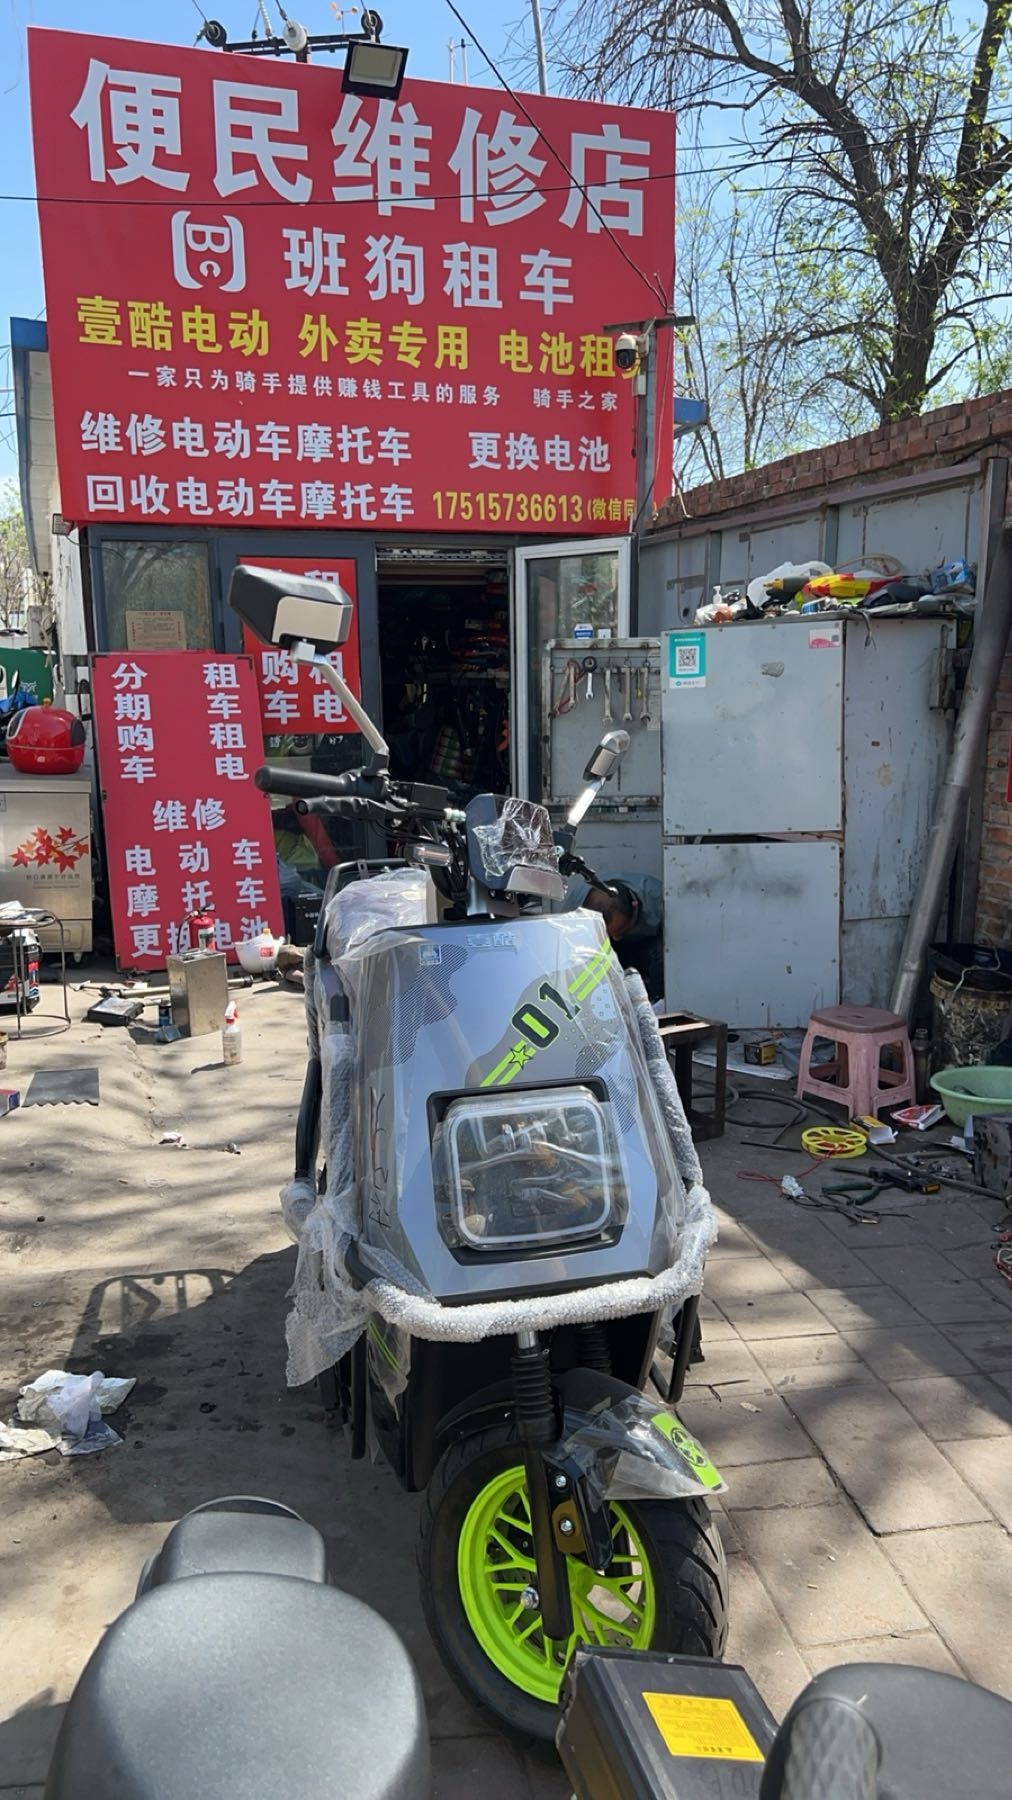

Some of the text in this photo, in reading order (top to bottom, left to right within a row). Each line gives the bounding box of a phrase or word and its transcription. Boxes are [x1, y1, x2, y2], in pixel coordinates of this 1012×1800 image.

[70, 58, 651, 236] 便民维修店
[282, 227, 574, 315] 班狗租车
[76, 295, 641, 379] 壹酷电动 外卖专用 电池租
[128, 366, 618, 411] 一家只为骑手提供赚钱工具的服务 骑手之家
[80, 411, 611, 472] 维修电动车摩托车 更换电池
[86, 474, 414, 522] 回收电动车摩托车
[433, 491, 583, 522] 17515736613
[153, 798, 226, 832] 维修
[511, 981, 581, 1050] 01
